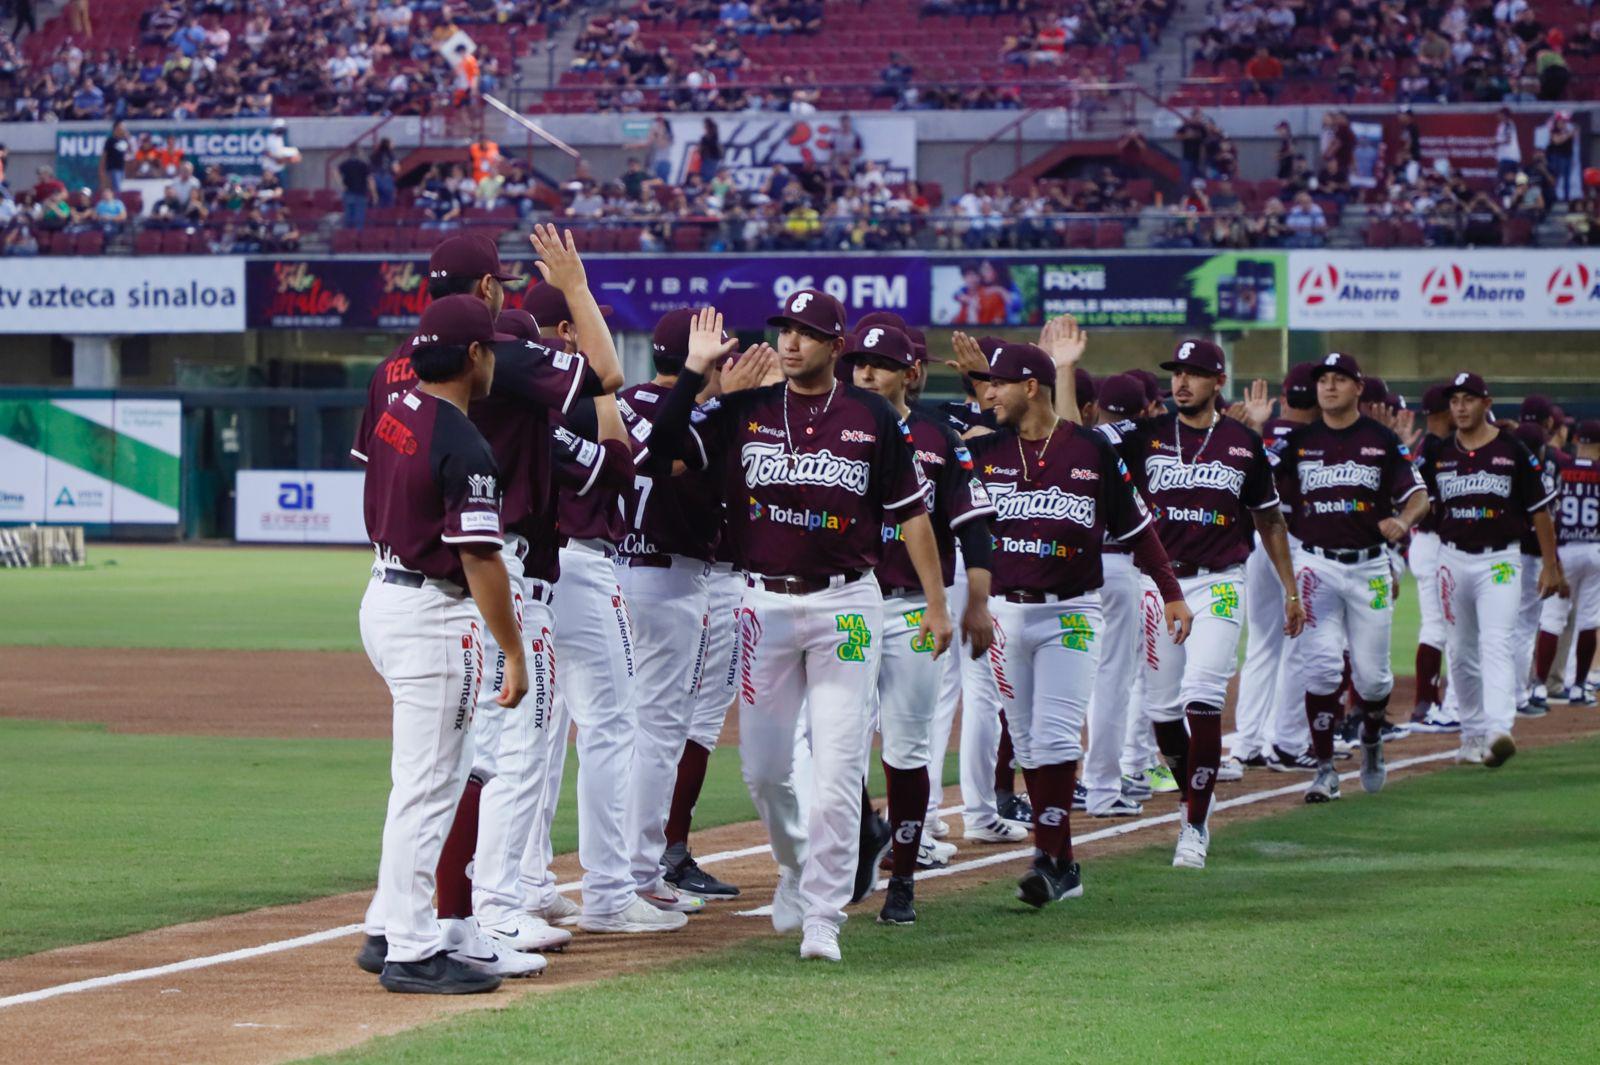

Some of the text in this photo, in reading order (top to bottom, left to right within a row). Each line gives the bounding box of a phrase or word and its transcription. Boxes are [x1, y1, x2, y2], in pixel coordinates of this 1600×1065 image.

[28, 284, 115, 307] azteca
[128, 281, 236, 307] sinaloa
[852, 275, 908, 309] FM
[1339, 284, 1400, 302] Ahorro
[1462, 284, 1526, 302] Ahorro
[741, 441, 871, 495] Tomateros
[1145, 455, 1246, 499] Tomatero
[768, 504, 850, 535] Totalplay
[985, 482, 1096, 528] Tomateros
[1562, 496, 1599, 527] 96
[624, 533, 658, 554] Cola
[615, 608, 635, 678] caliente.mx
[454, 650, 474, 731] caliente.mx
[534, 653, 546, 728] caliente.mx
